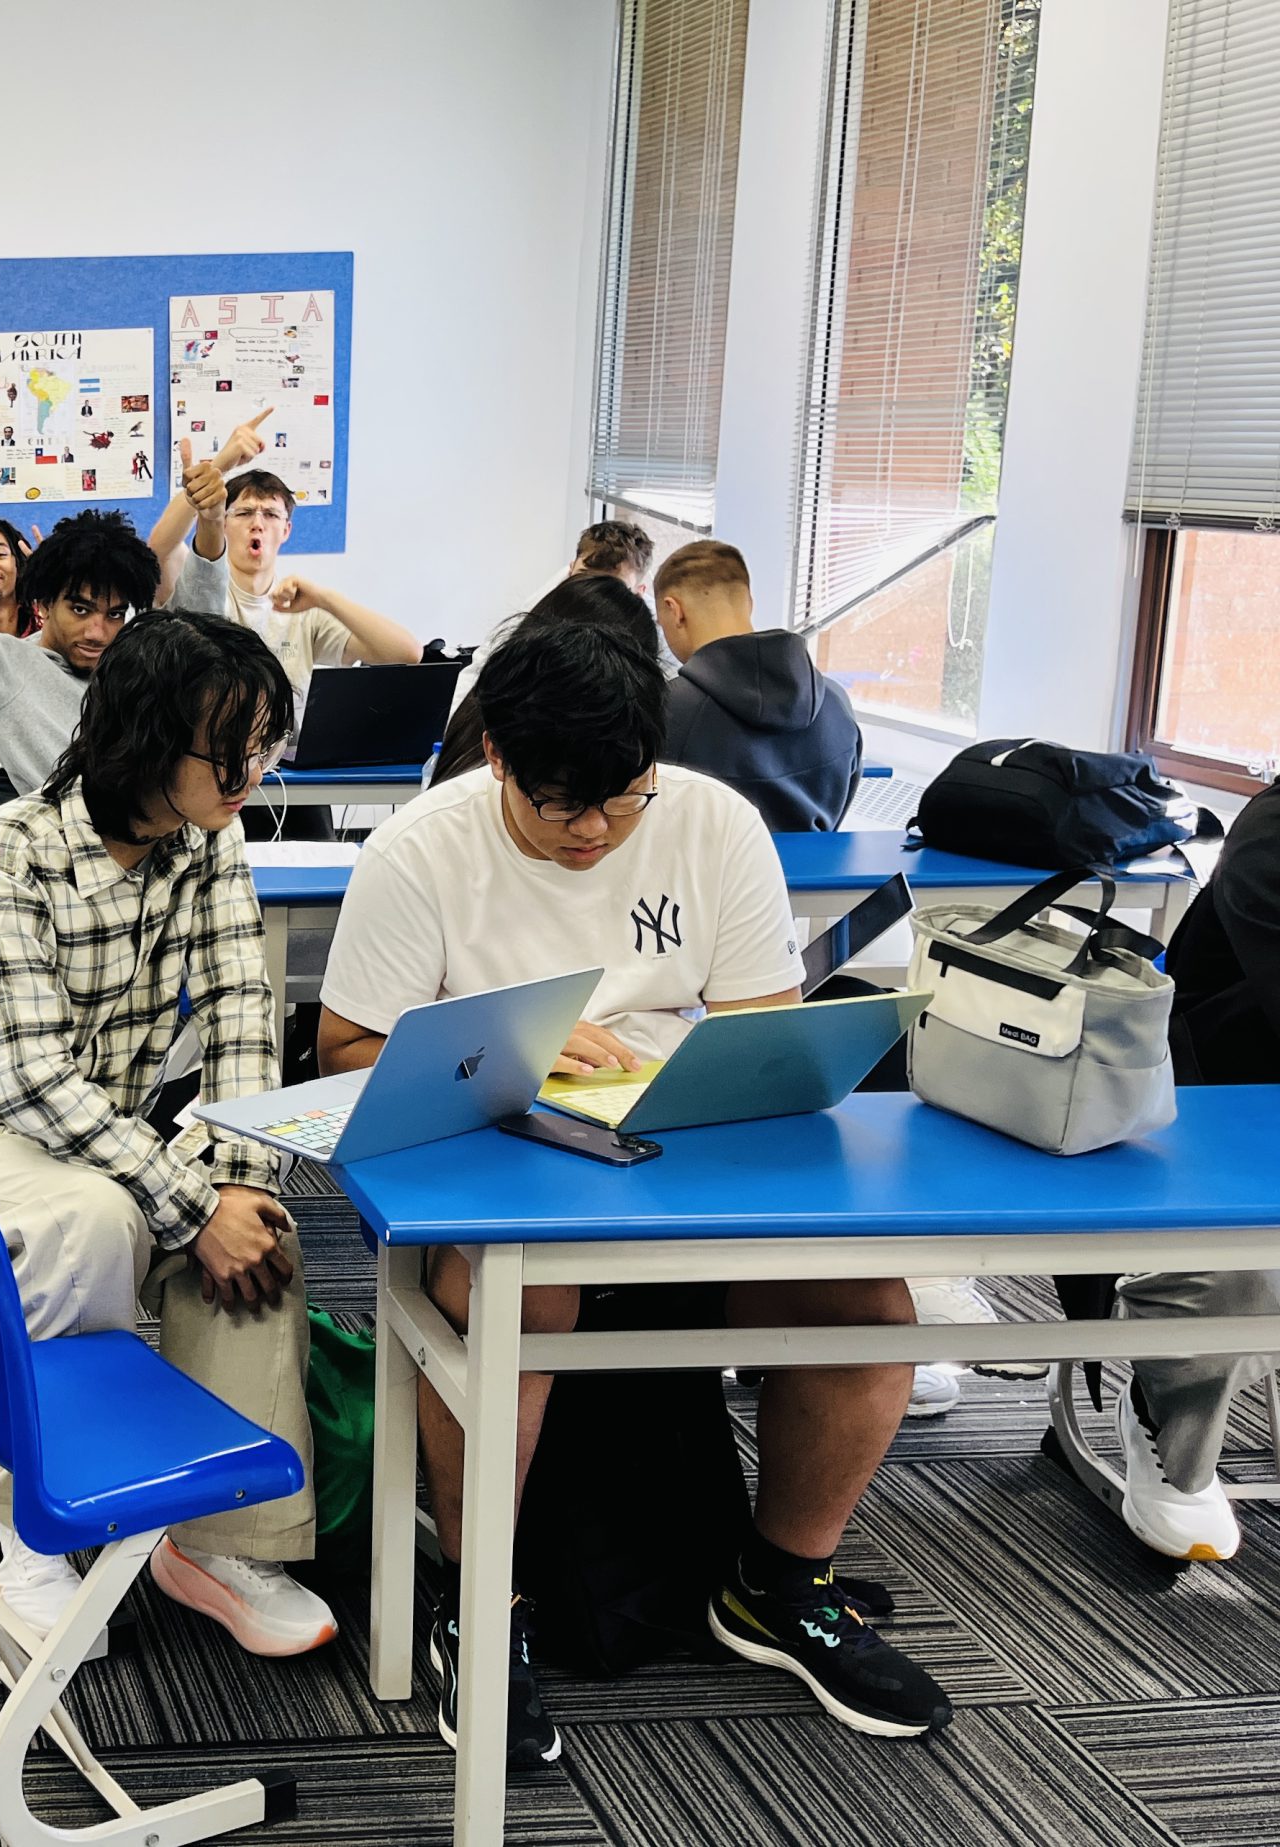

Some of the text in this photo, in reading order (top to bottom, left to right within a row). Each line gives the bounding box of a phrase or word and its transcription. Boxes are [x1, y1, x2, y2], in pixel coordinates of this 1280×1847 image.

[180, 293, 324, 329] ASIA
[14, 332, 82, 348] SOUTH
[630, 893, 682, 954] NY
